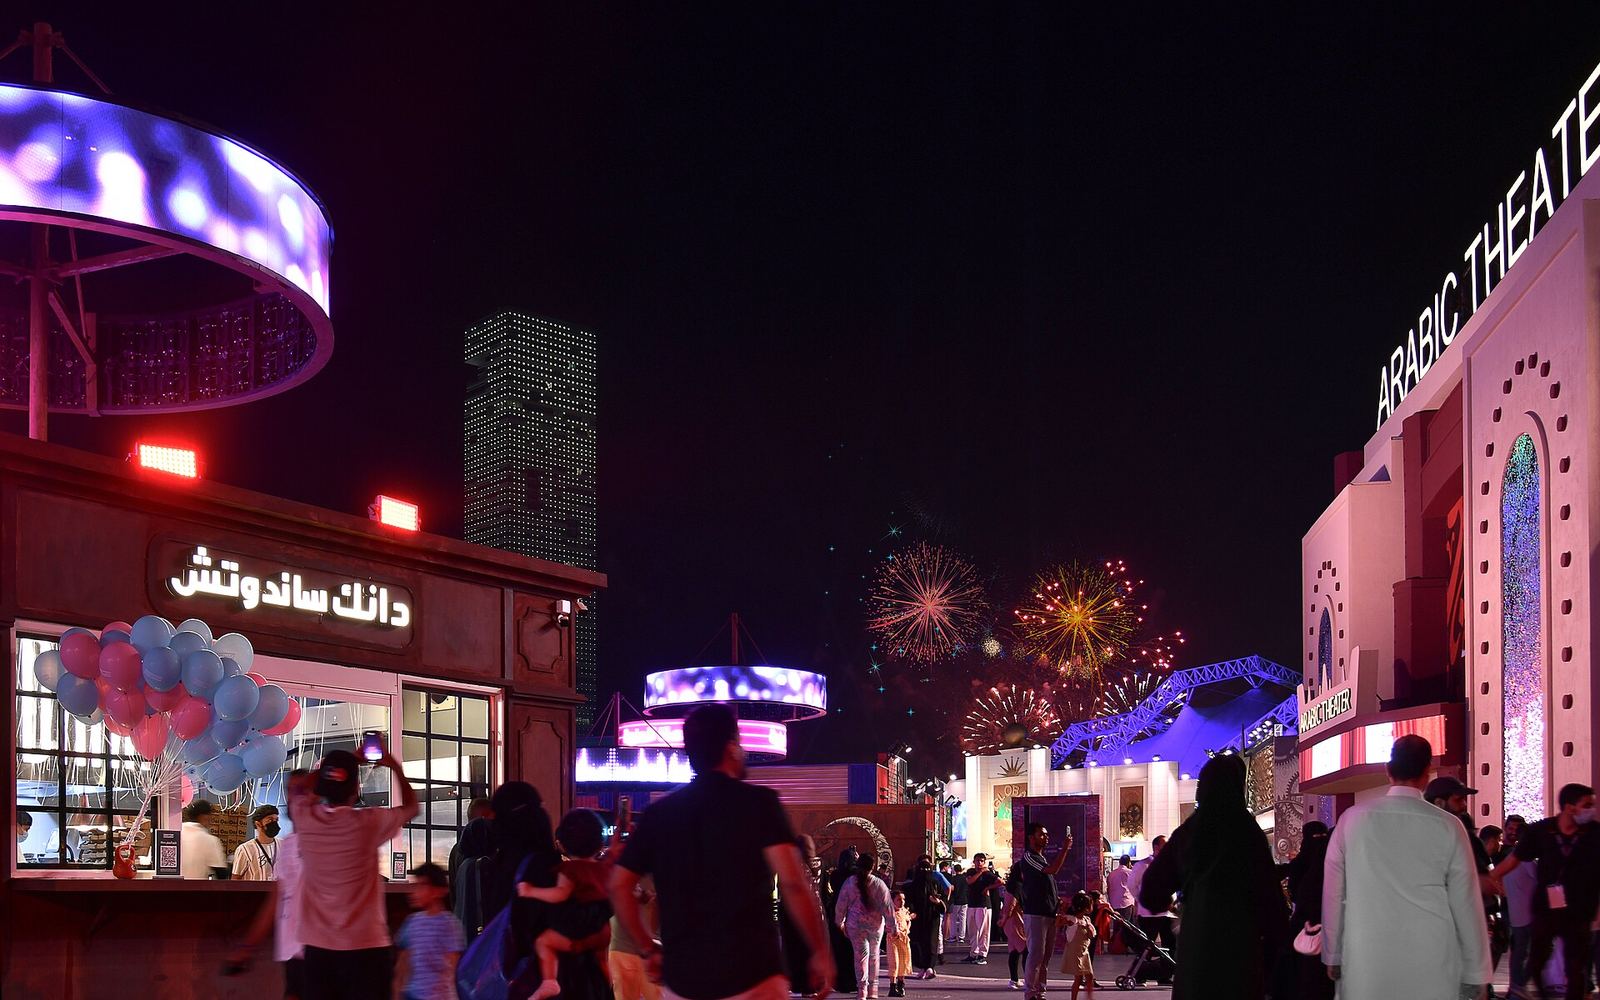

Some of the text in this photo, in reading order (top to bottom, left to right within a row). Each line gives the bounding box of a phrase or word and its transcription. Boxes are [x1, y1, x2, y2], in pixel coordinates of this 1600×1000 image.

[1376, 271, 1458, 431] ARABIC
[171, 545, 410, 628] دانك ساندوتش
[1299, 688, 1352, 733] ARABIC THEATER
